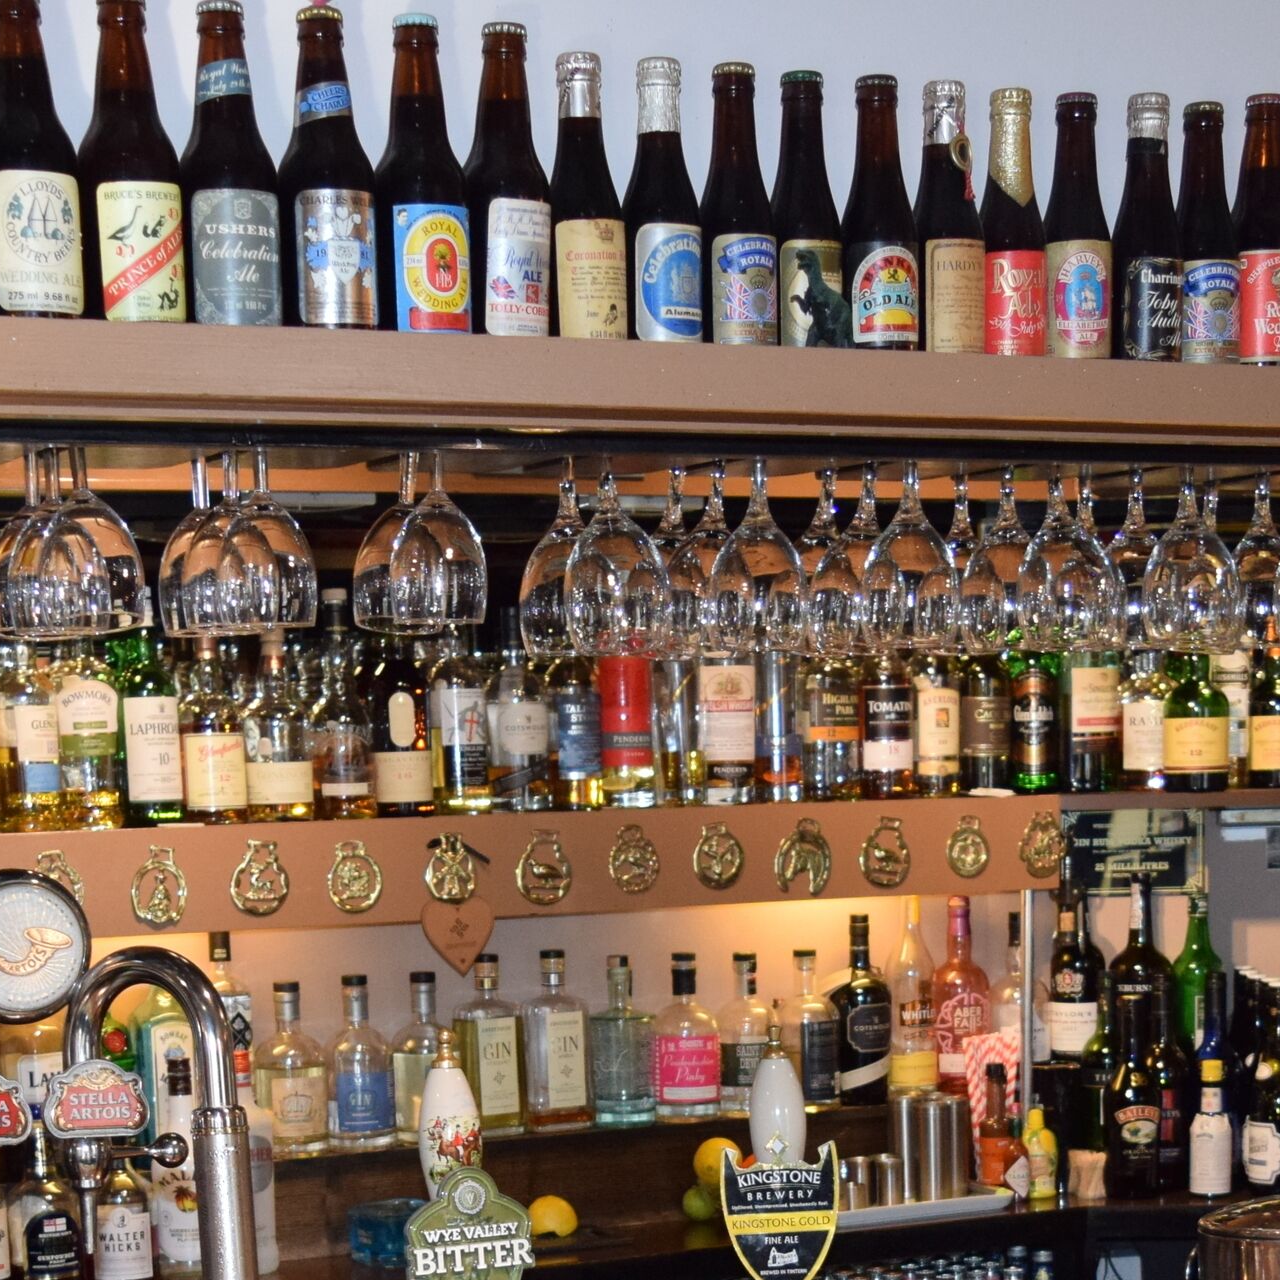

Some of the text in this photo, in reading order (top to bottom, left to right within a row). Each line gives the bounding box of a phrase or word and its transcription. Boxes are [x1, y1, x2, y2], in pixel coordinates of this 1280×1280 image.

[20, 180, 65, 202] LLOYDS
[103, 189, 143, 201] BRUCE'S
[300, 194, 346, 207] CHARLES
[204, 223, 276, 239] USHERS
[421, 221, 459, 240] ROYAL
[4, 221, 52, 264] COUNTRY
[200, 241, 280, 262] Celebration
[503, 247, 533, 269] Royal
[565, 250, 618, 263] Coronation
[643, 237, 701, 285] Celebration
[740, 256, 774, 267] ROYALE
[1058, 252, 1108, 283] HARVEYS
[0, 269, 83, 289] WEDDING ALE
[107, 258, 156, 297] PRINCE
[226, 268, 261, 284] Ale
[521, 270, 543, 283] ALE
[1202, 279, 1235, 291] ROYALE
[7, 290, 25, 301] 275
[43, 291, 63, 303] 9.68
[411, 275, 459, 311] WEDDING
[862, 294, 917, 312] OLD ALE
[1138, 291, 1178, 313] Toby
[1077, 332, 1096, 341] ALE
[61, 688, 114, 708] BOWMORE
[867, 699, 913, 714] TOMATIN
[888, 744, 900, 754] 18
[157, 751, 170, 766] 10
[1151, 834, 1193, 847] WHISKY
[1094, 862, 1104, 871] 25
[8, 948, 48, 973] ARTOIS
[953, 1005, 983, 1018] ABER
[482, 1040, 512, 1059] GIN
[675, 1066, 706, 1084] Pinky
[70, 1091, 130, 1106] STELLA
[69, 1106, 132, 1121] ARTOIS
[736, 1169, 822, 1188] KINGSTONE
[746, 1189, 814, 1202] BREWERY
[732, 1215, 831, 1230] KINGSTONE GOLD
[98, 1230, 146, 1243] WALTER
[423, 1221, 520, 1246] WYE VALLEY
[764, 1235, 800, 1245] FINE ALE
[103, 1242, 142, 1254] HICKS
[413, 1238, 534, 1277] BITTER
[760, 1269, 780, 1277] BREWED
